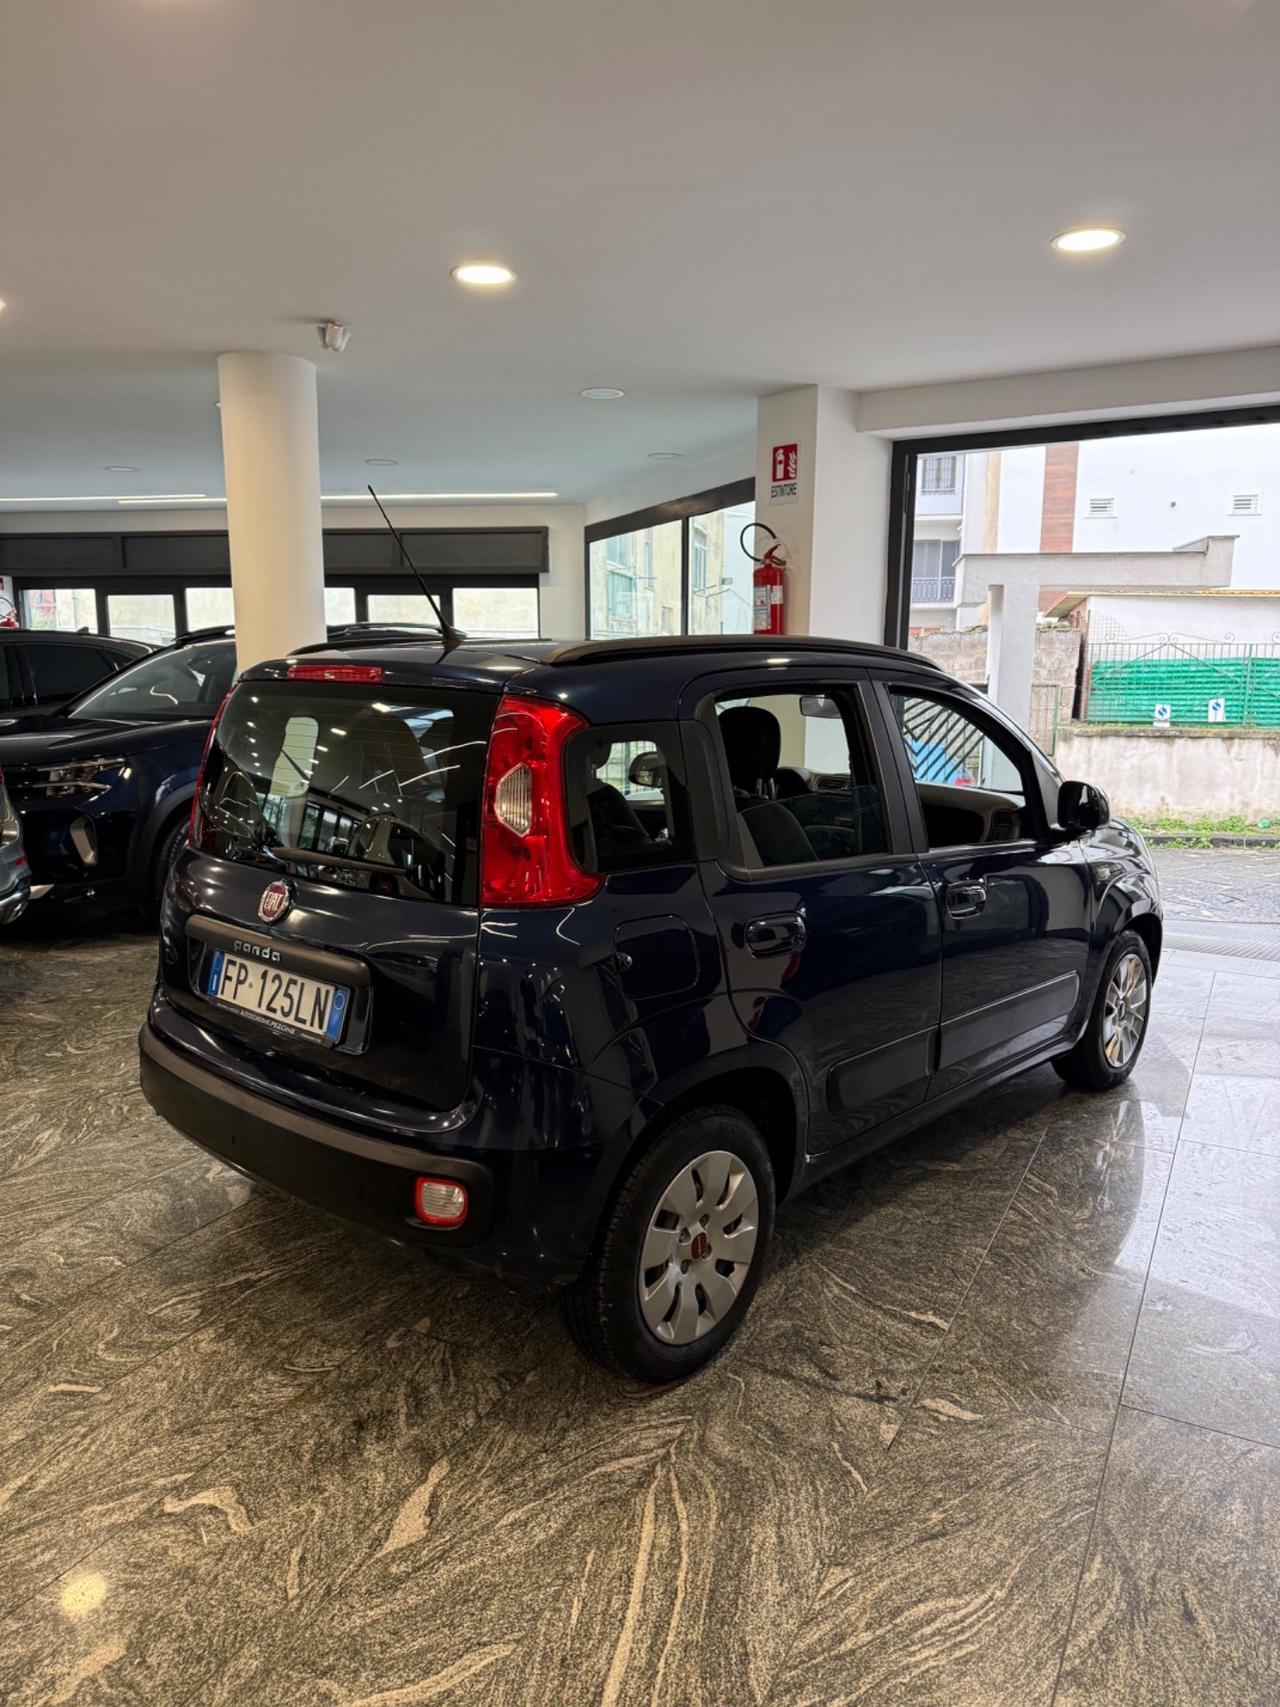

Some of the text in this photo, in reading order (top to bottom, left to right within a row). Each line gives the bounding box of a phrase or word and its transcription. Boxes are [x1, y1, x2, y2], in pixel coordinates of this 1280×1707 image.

[263, 891, 284, 911] FIAT
[233, 940, 281, 962] panda
[257, 969, 330, 1030] 125LN
